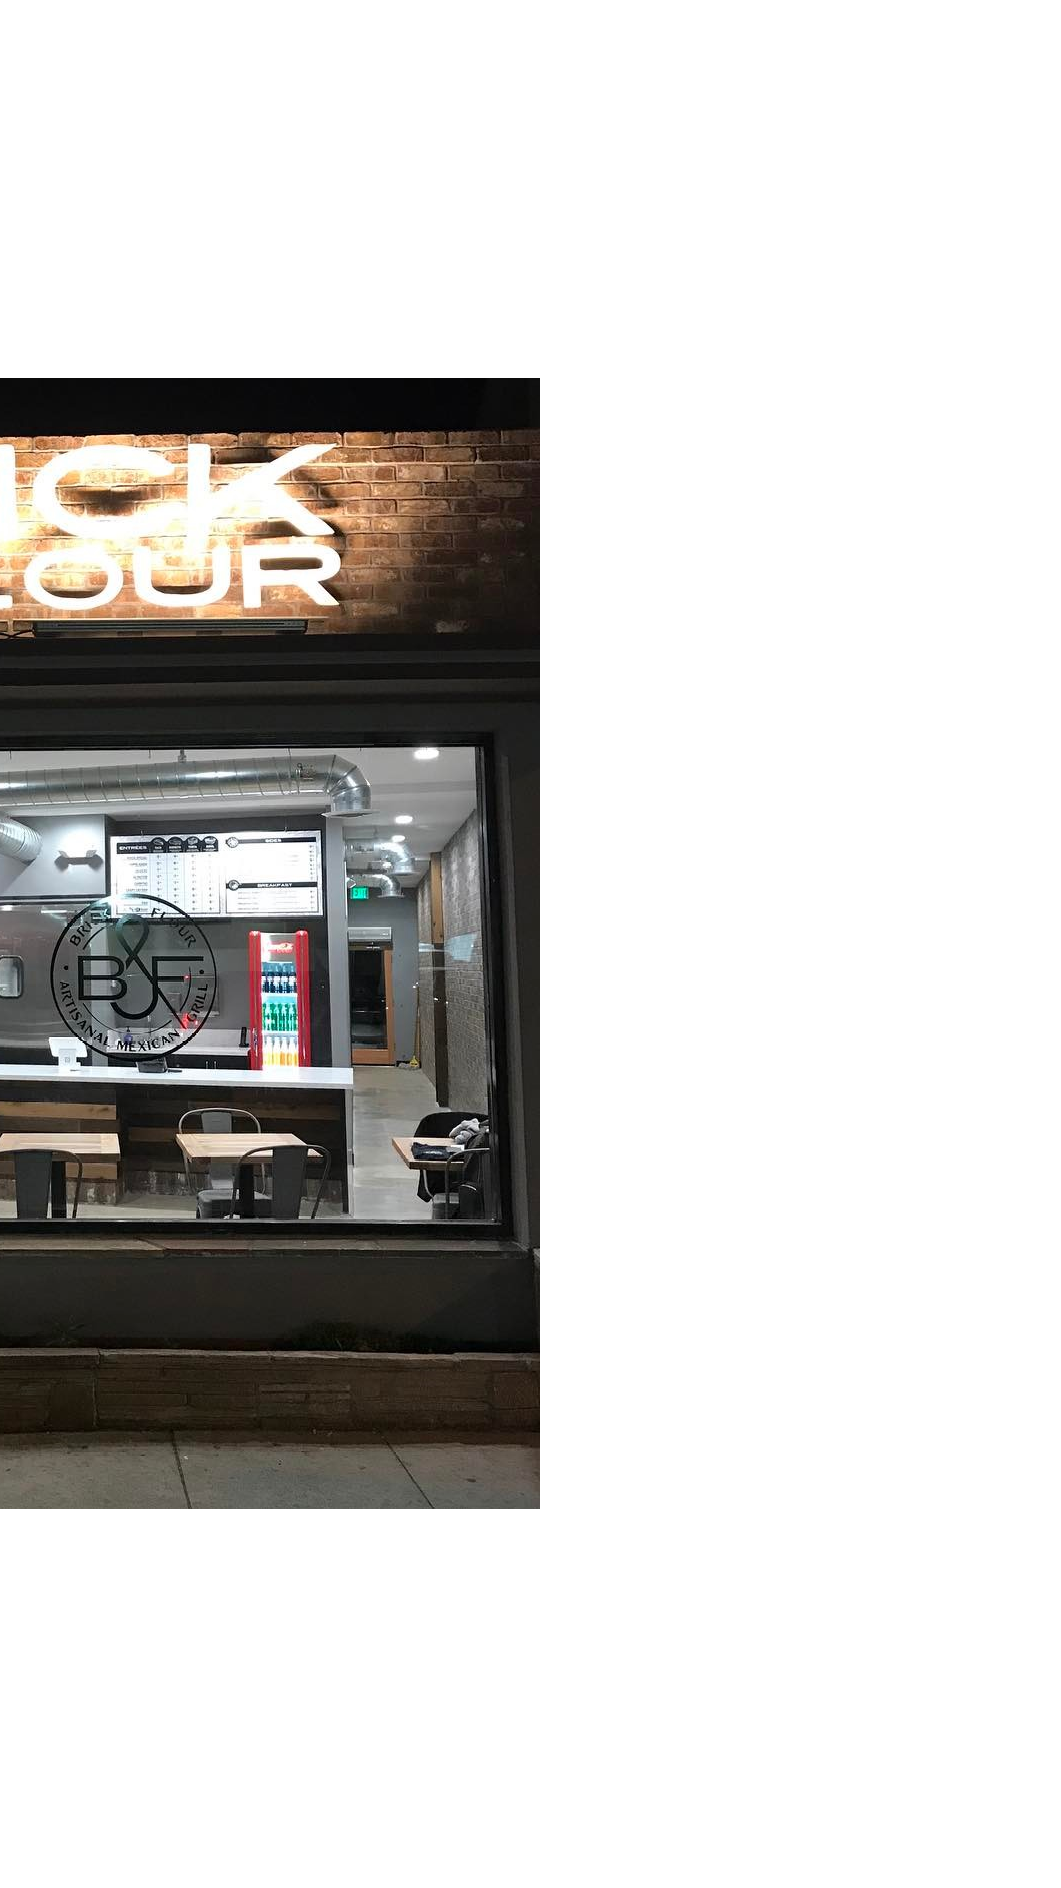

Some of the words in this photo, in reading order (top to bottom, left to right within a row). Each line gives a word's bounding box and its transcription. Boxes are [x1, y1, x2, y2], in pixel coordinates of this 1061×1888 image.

[59, 981, 111, 1047] ARTISANAL
[116, 1028, 181, 1053] MEXICAN
[186, 983, 209, 1023] GRILL
